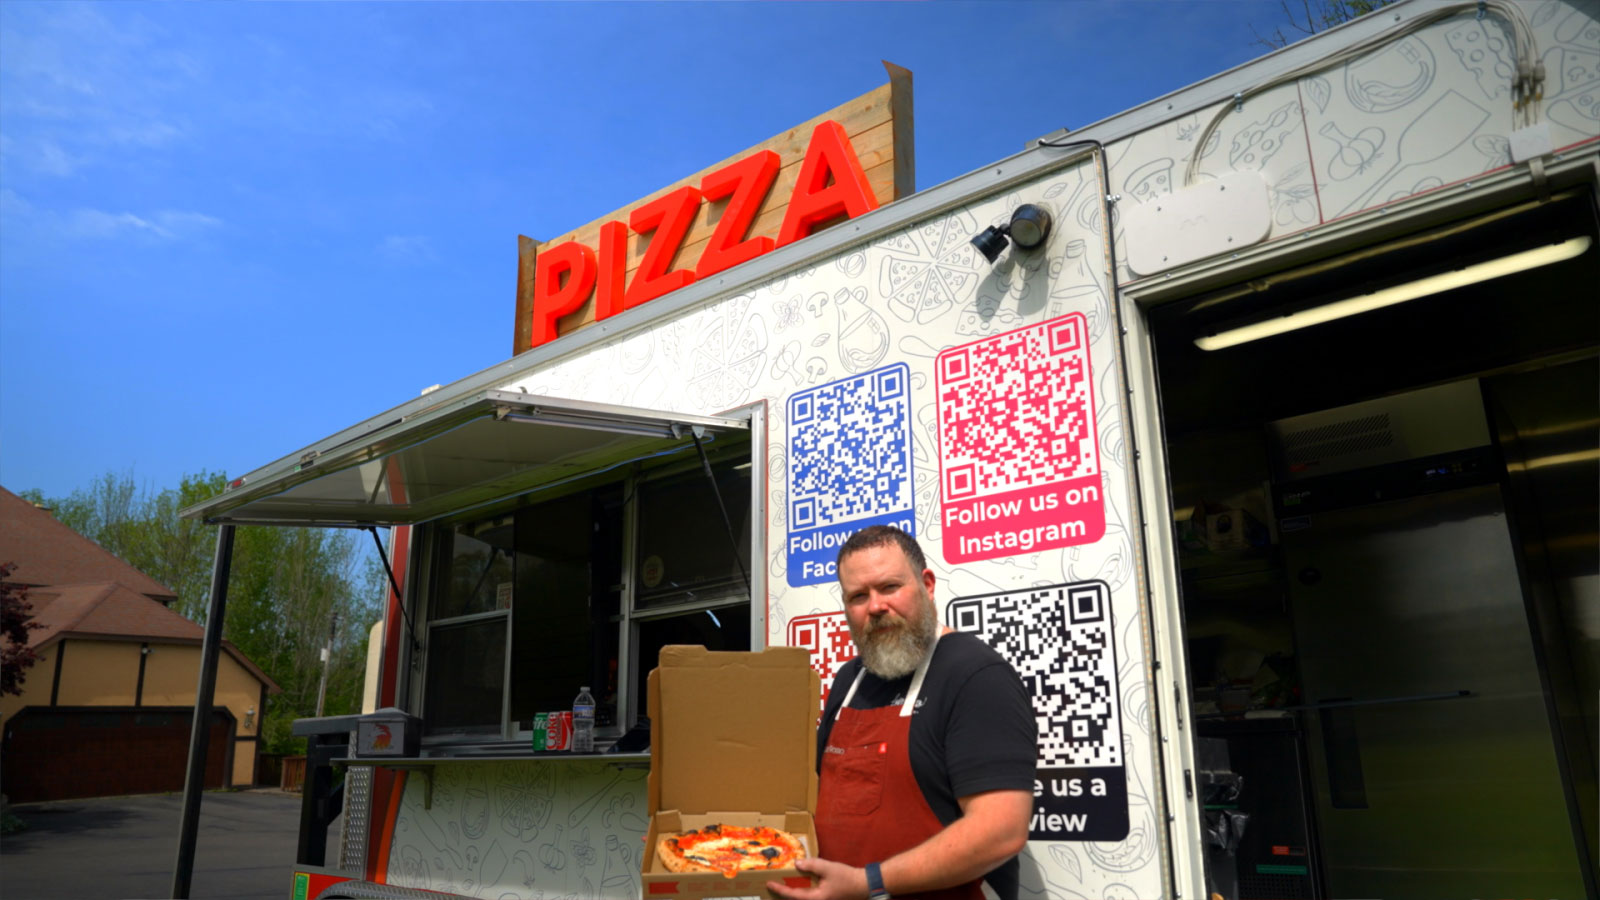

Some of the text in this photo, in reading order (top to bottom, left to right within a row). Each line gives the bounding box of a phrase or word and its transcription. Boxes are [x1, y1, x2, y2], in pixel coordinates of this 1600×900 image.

[532, 119, 879, 348] PIZZA
[945, 485, 1099, 528] Follow us on
[790, 531, 852, 555] Follow
[959, 519, 1086, 555] Instagram
[802, 560, 838, 579] Fac
[1051, 777, 1084, 797] us
[1090, 777, 1107, 797] a
[1028, 806, 1088, 832] view
